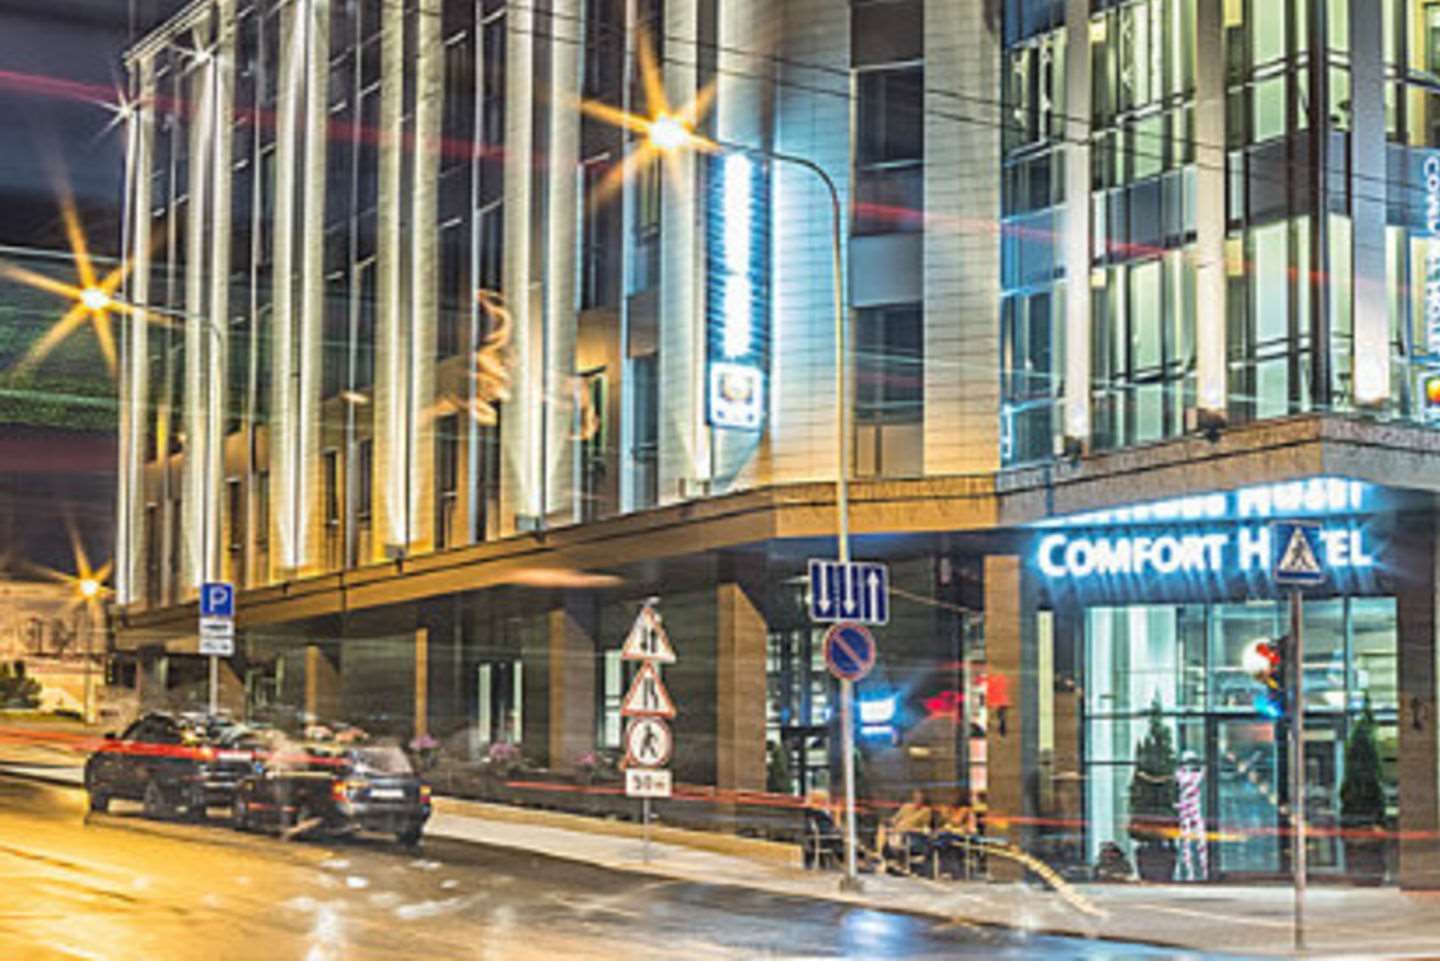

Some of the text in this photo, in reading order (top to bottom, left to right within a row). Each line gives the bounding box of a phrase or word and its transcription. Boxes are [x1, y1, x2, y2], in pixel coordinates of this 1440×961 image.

[1038, 526, 1371, 577] COMFORT HEL
[209, 586, 228, 612] P
